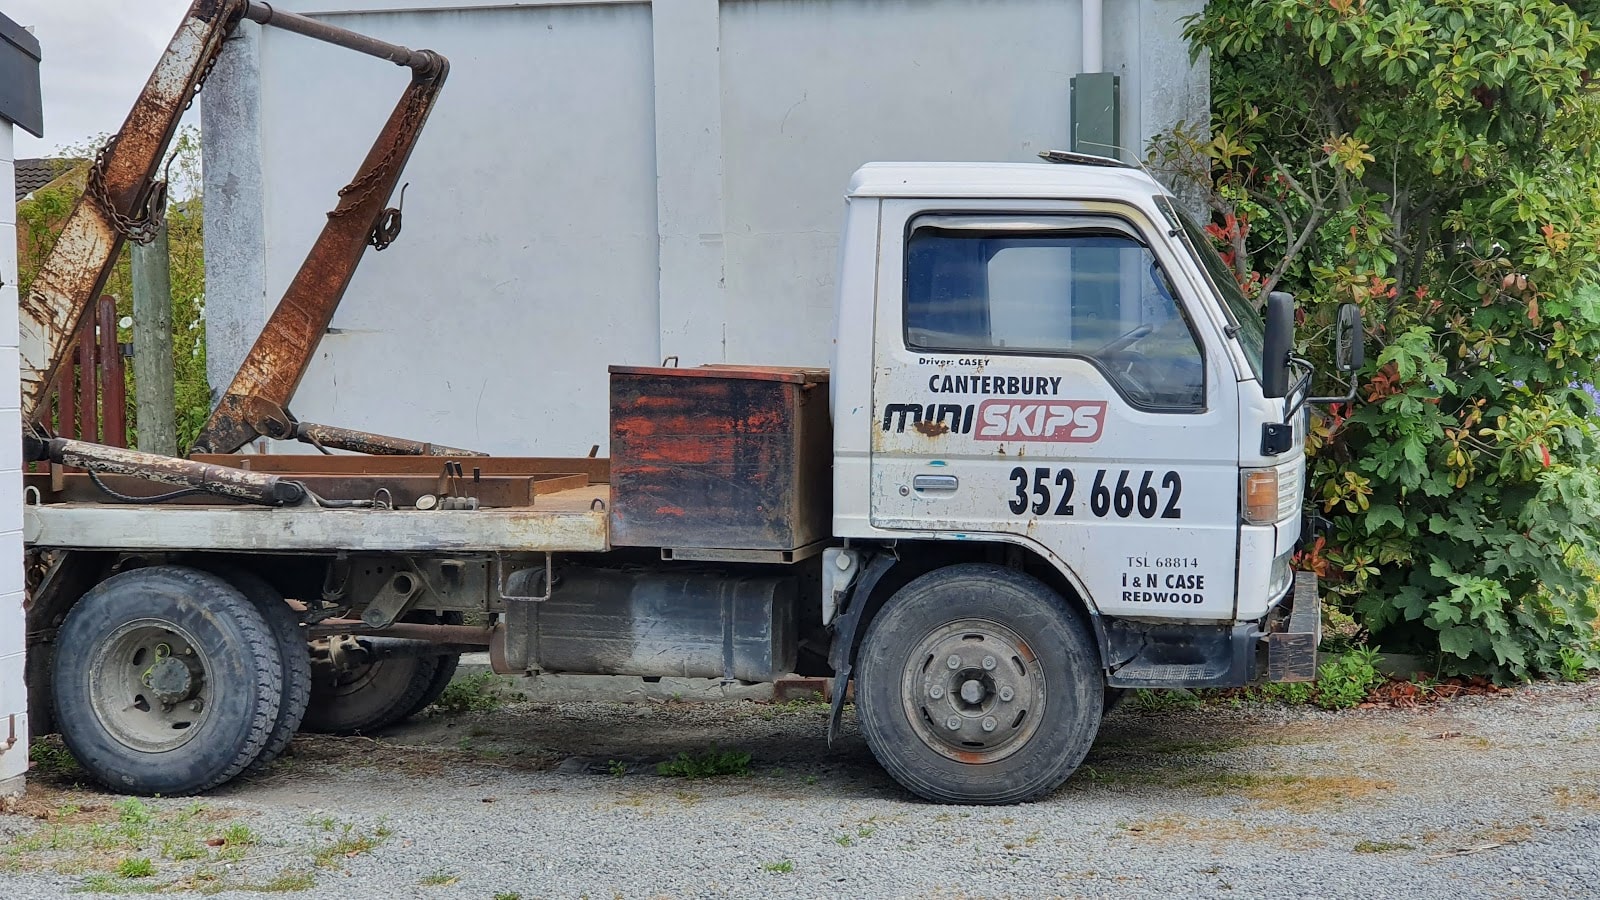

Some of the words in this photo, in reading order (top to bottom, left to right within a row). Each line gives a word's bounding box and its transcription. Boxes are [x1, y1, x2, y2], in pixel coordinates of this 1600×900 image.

[918, 357, 955, 366] Driver:
[958, 358, 991, 366] CASEY
[928, 374, 1062, 395] CANTERBURY
[980, 404, 1101, 437] SKIPS
[1008, 466, 1075, 516] 352
[1090, 469, 1182, 519] 6662
[1126, 556, 1151, 568] TSL
[1155, 557, 1199, 568] 68814
[1132, 576, 1142, 588] &
[1146, 573, 1158, 588] N
[1165, 574, 1205, 590] CASE
[1122, 591, 1204, 604] REDWOOD
